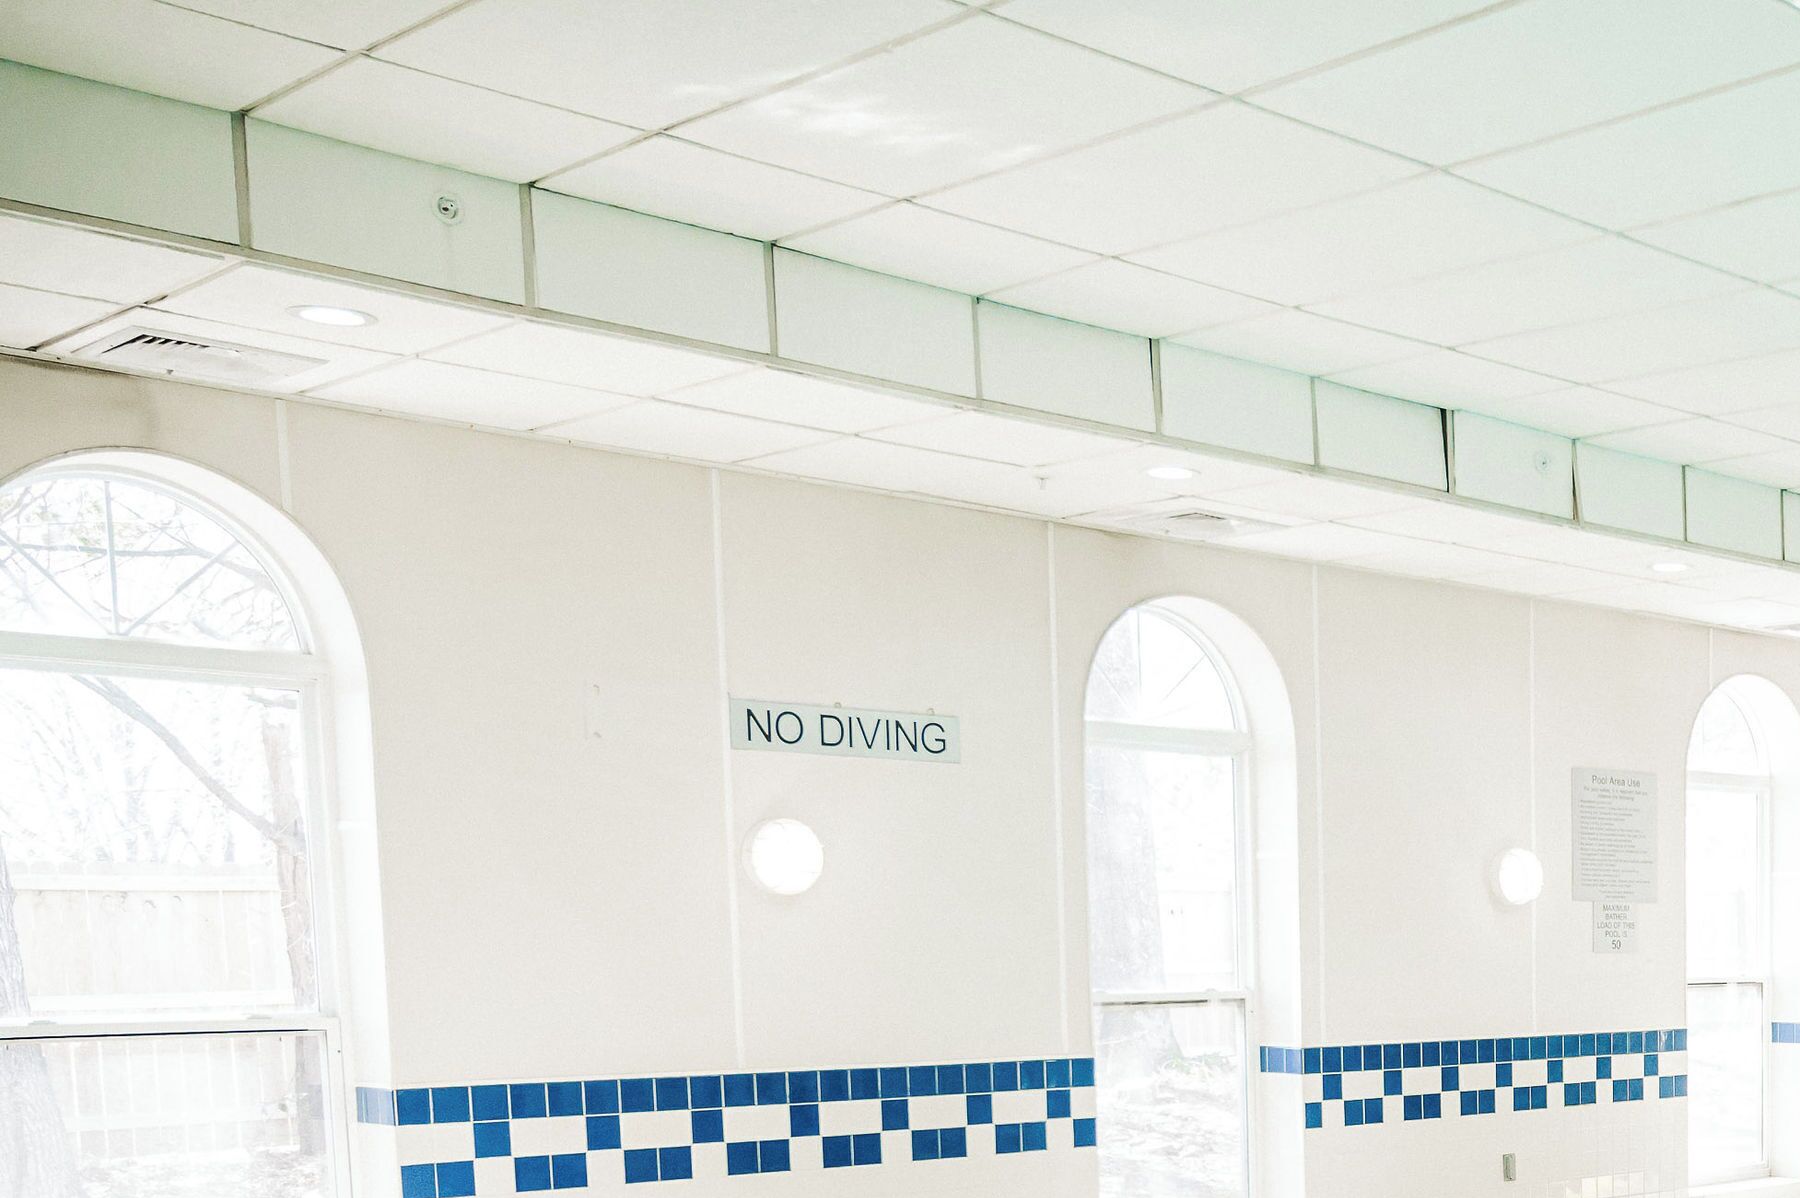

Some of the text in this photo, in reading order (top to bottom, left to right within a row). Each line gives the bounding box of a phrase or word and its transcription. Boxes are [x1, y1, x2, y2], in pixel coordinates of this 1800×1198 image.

[746, 708, 947, 755] NO DIVING
[1592, 775, 1641, 788] Pool Area Use
[1611, 939, 1622, 950] 50
